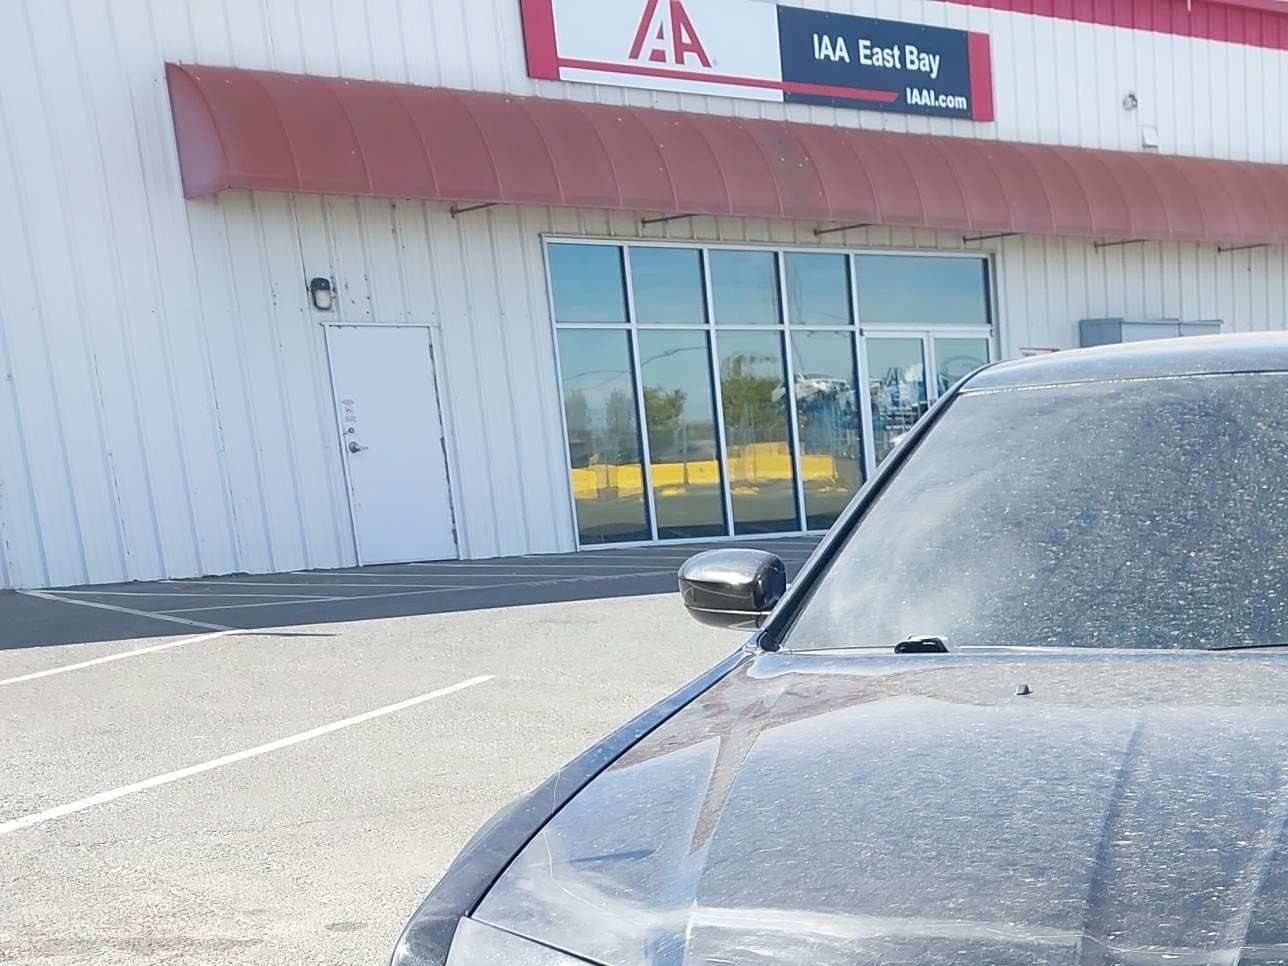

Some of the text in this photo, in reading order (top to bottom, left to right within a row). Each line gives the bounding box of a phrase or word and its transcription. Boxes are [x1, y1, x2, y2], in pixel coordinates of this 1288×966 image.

[813, 33, 940, 79] IAA East Bay
[906, 87, 967, 110] IAAI.com
